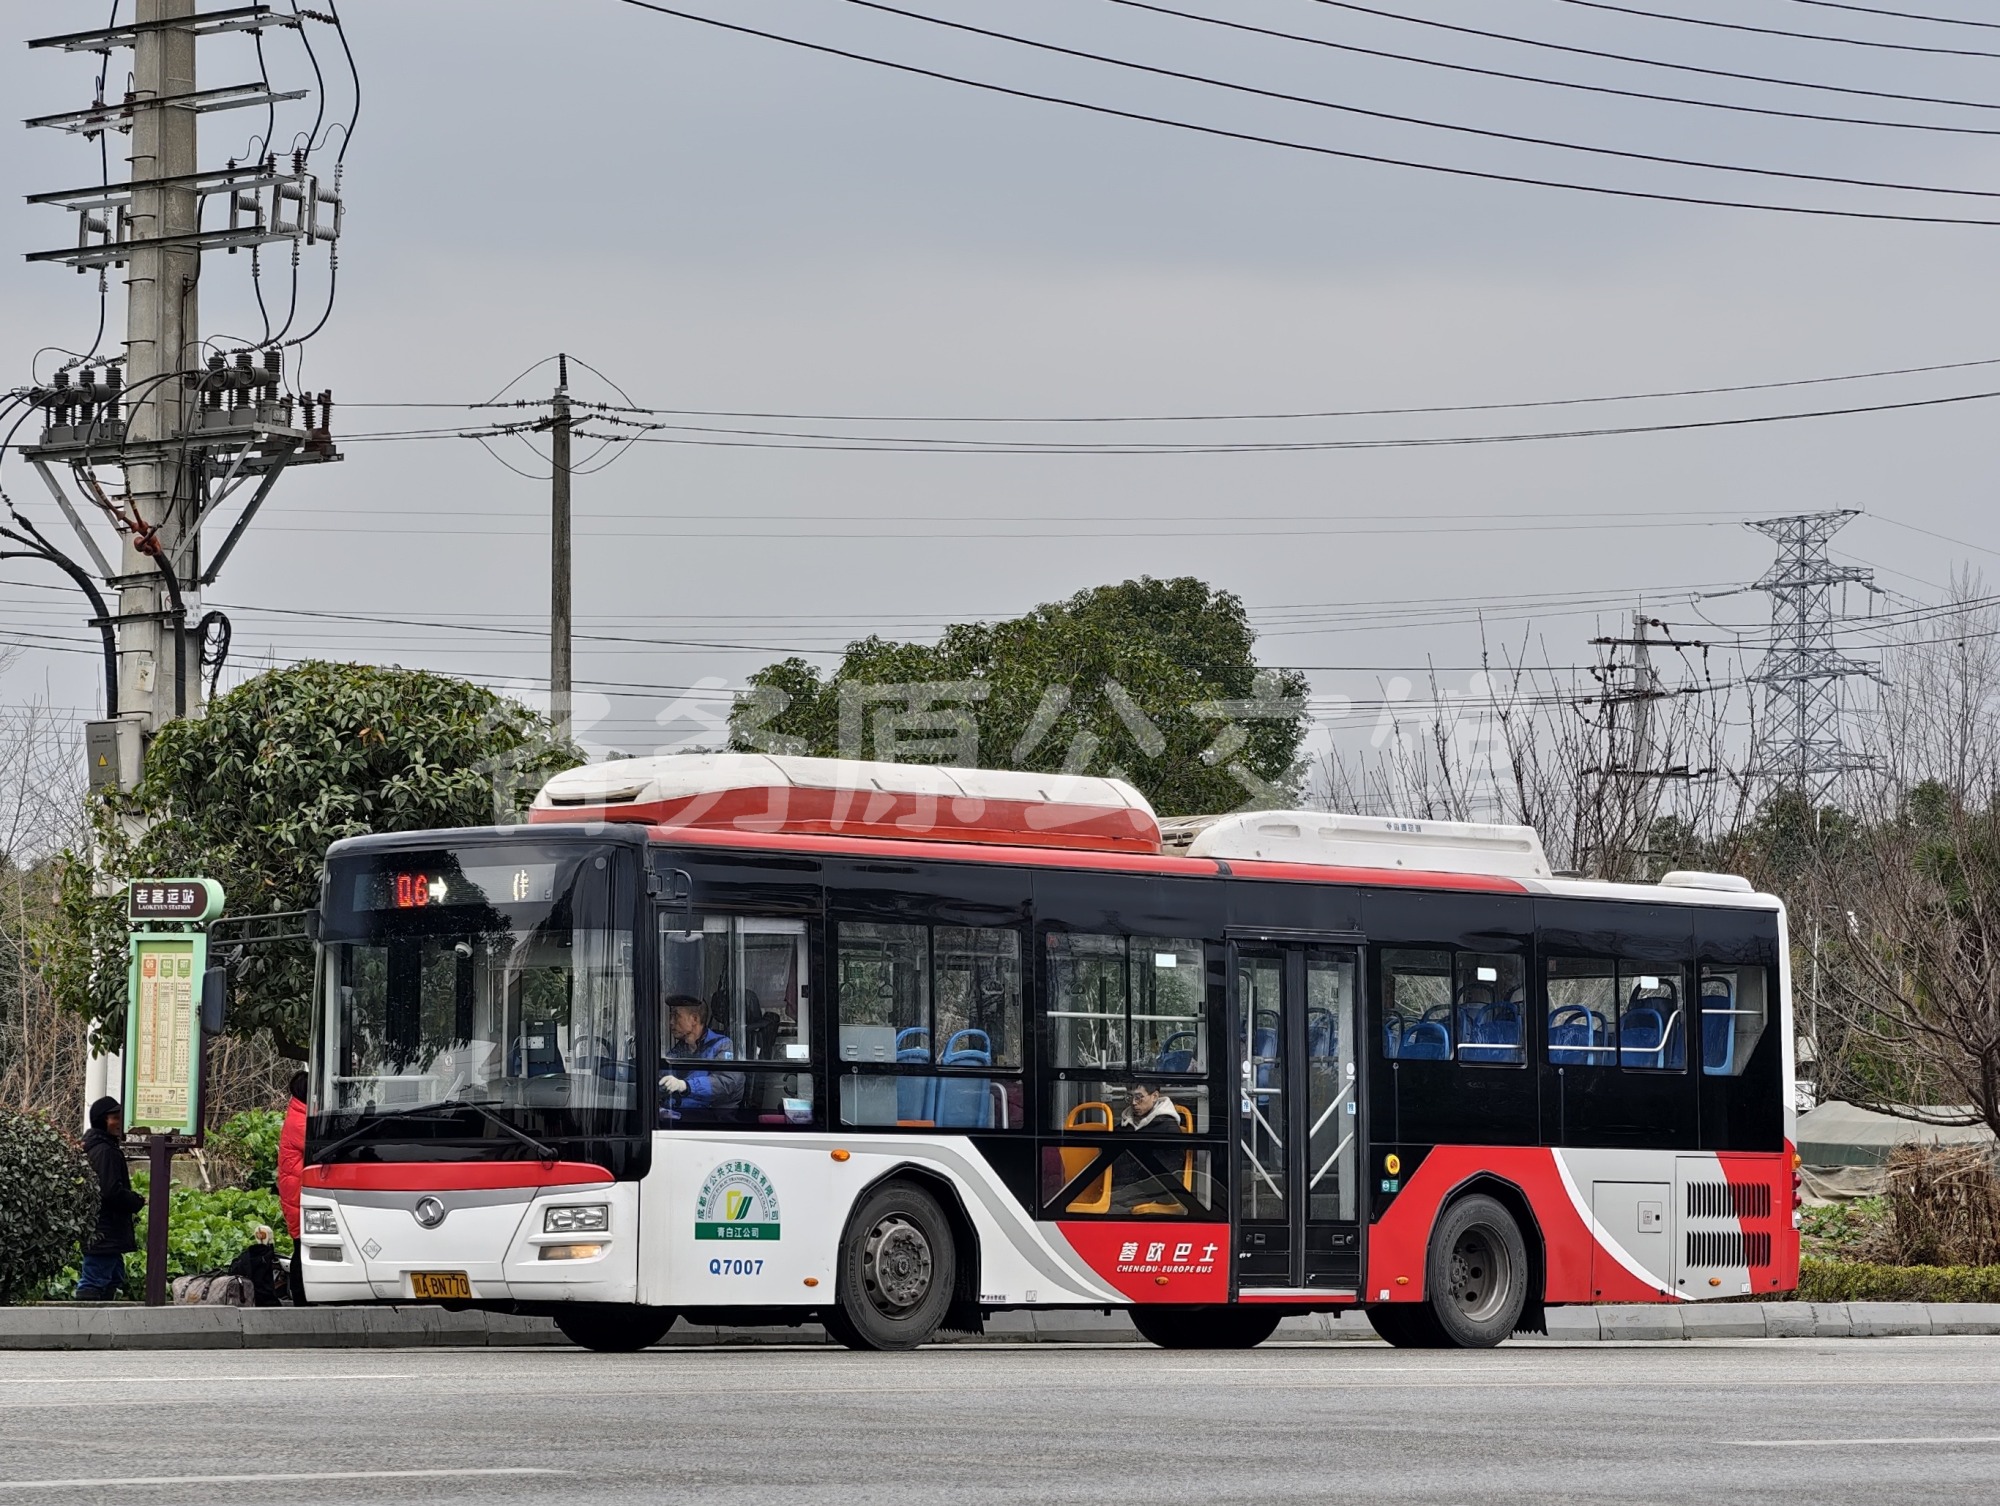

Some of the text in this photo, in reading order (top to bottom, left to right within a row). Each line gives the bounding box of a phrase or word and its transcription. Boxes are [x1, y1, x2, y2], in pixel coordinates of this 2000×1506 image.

[136, 888, 195, 904] 老客运站
[696, 1161, 779, 1221] 成都市公共交通集团有限公司
[717, 1226, 760, 1239] 青白江公司
[1118, 1241, 1219, 1263] 蓉欧巴士
[709, 1258, 764, 1275] Q7007
[1195, 1265, 1213, 1273] BUS
